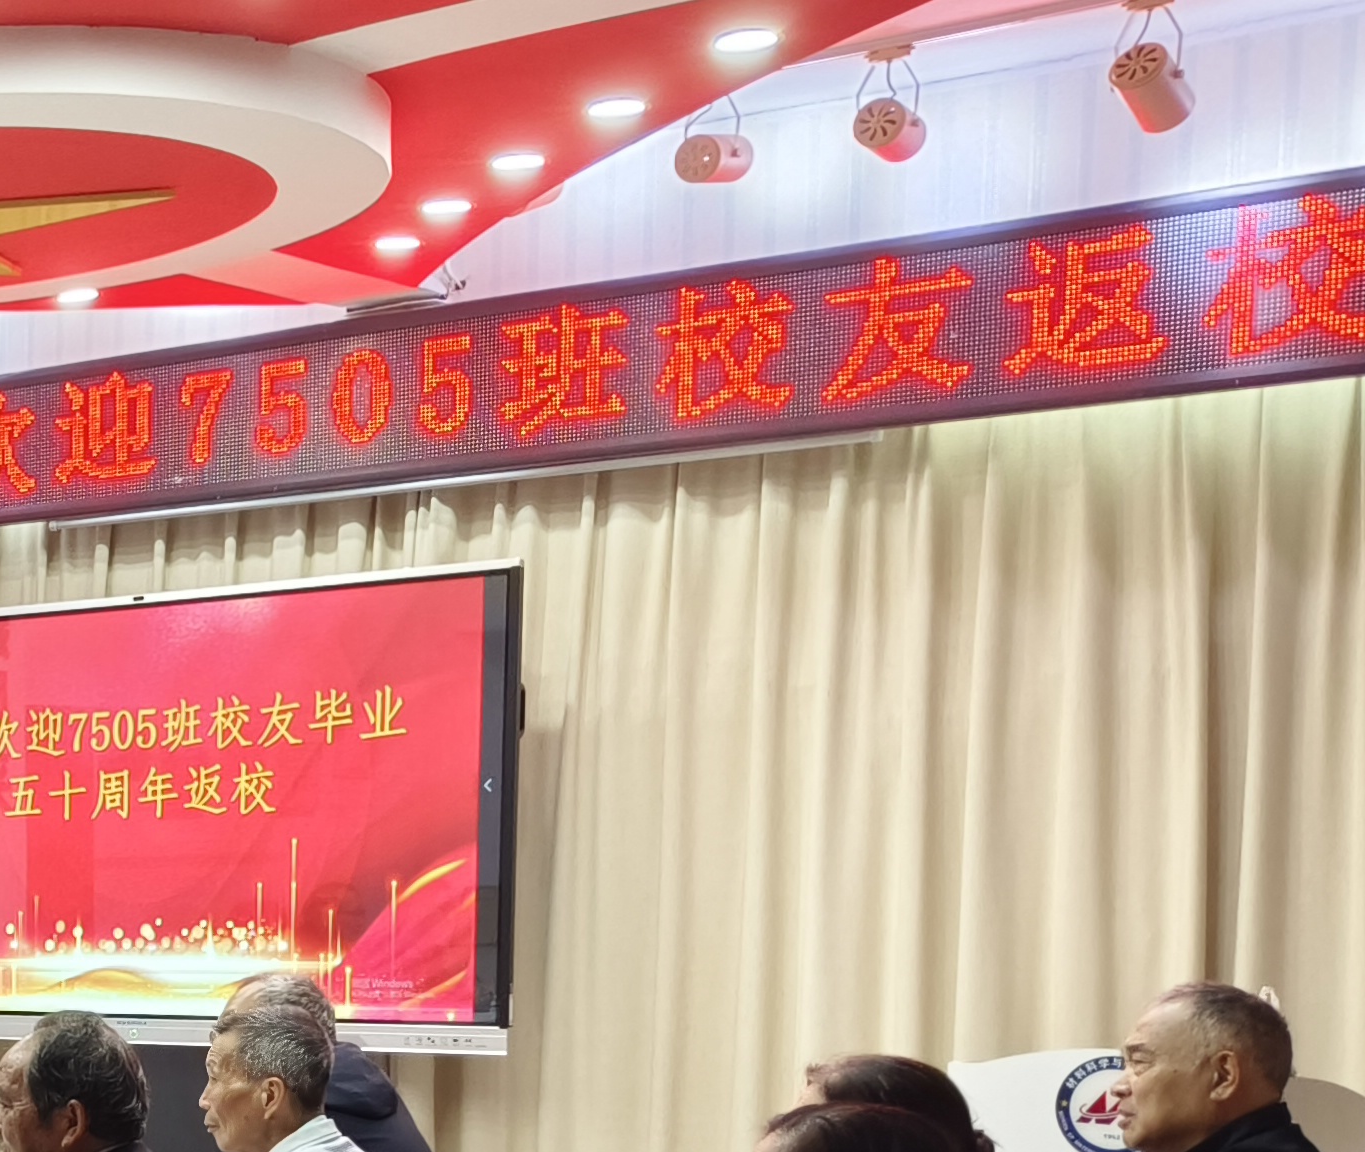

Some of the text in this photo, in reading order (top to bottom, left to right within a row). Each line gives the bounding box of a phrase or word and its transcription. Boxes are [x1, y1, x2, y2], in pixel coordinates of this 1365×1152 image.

[4, 761, 277, 821] 五十周年返校
